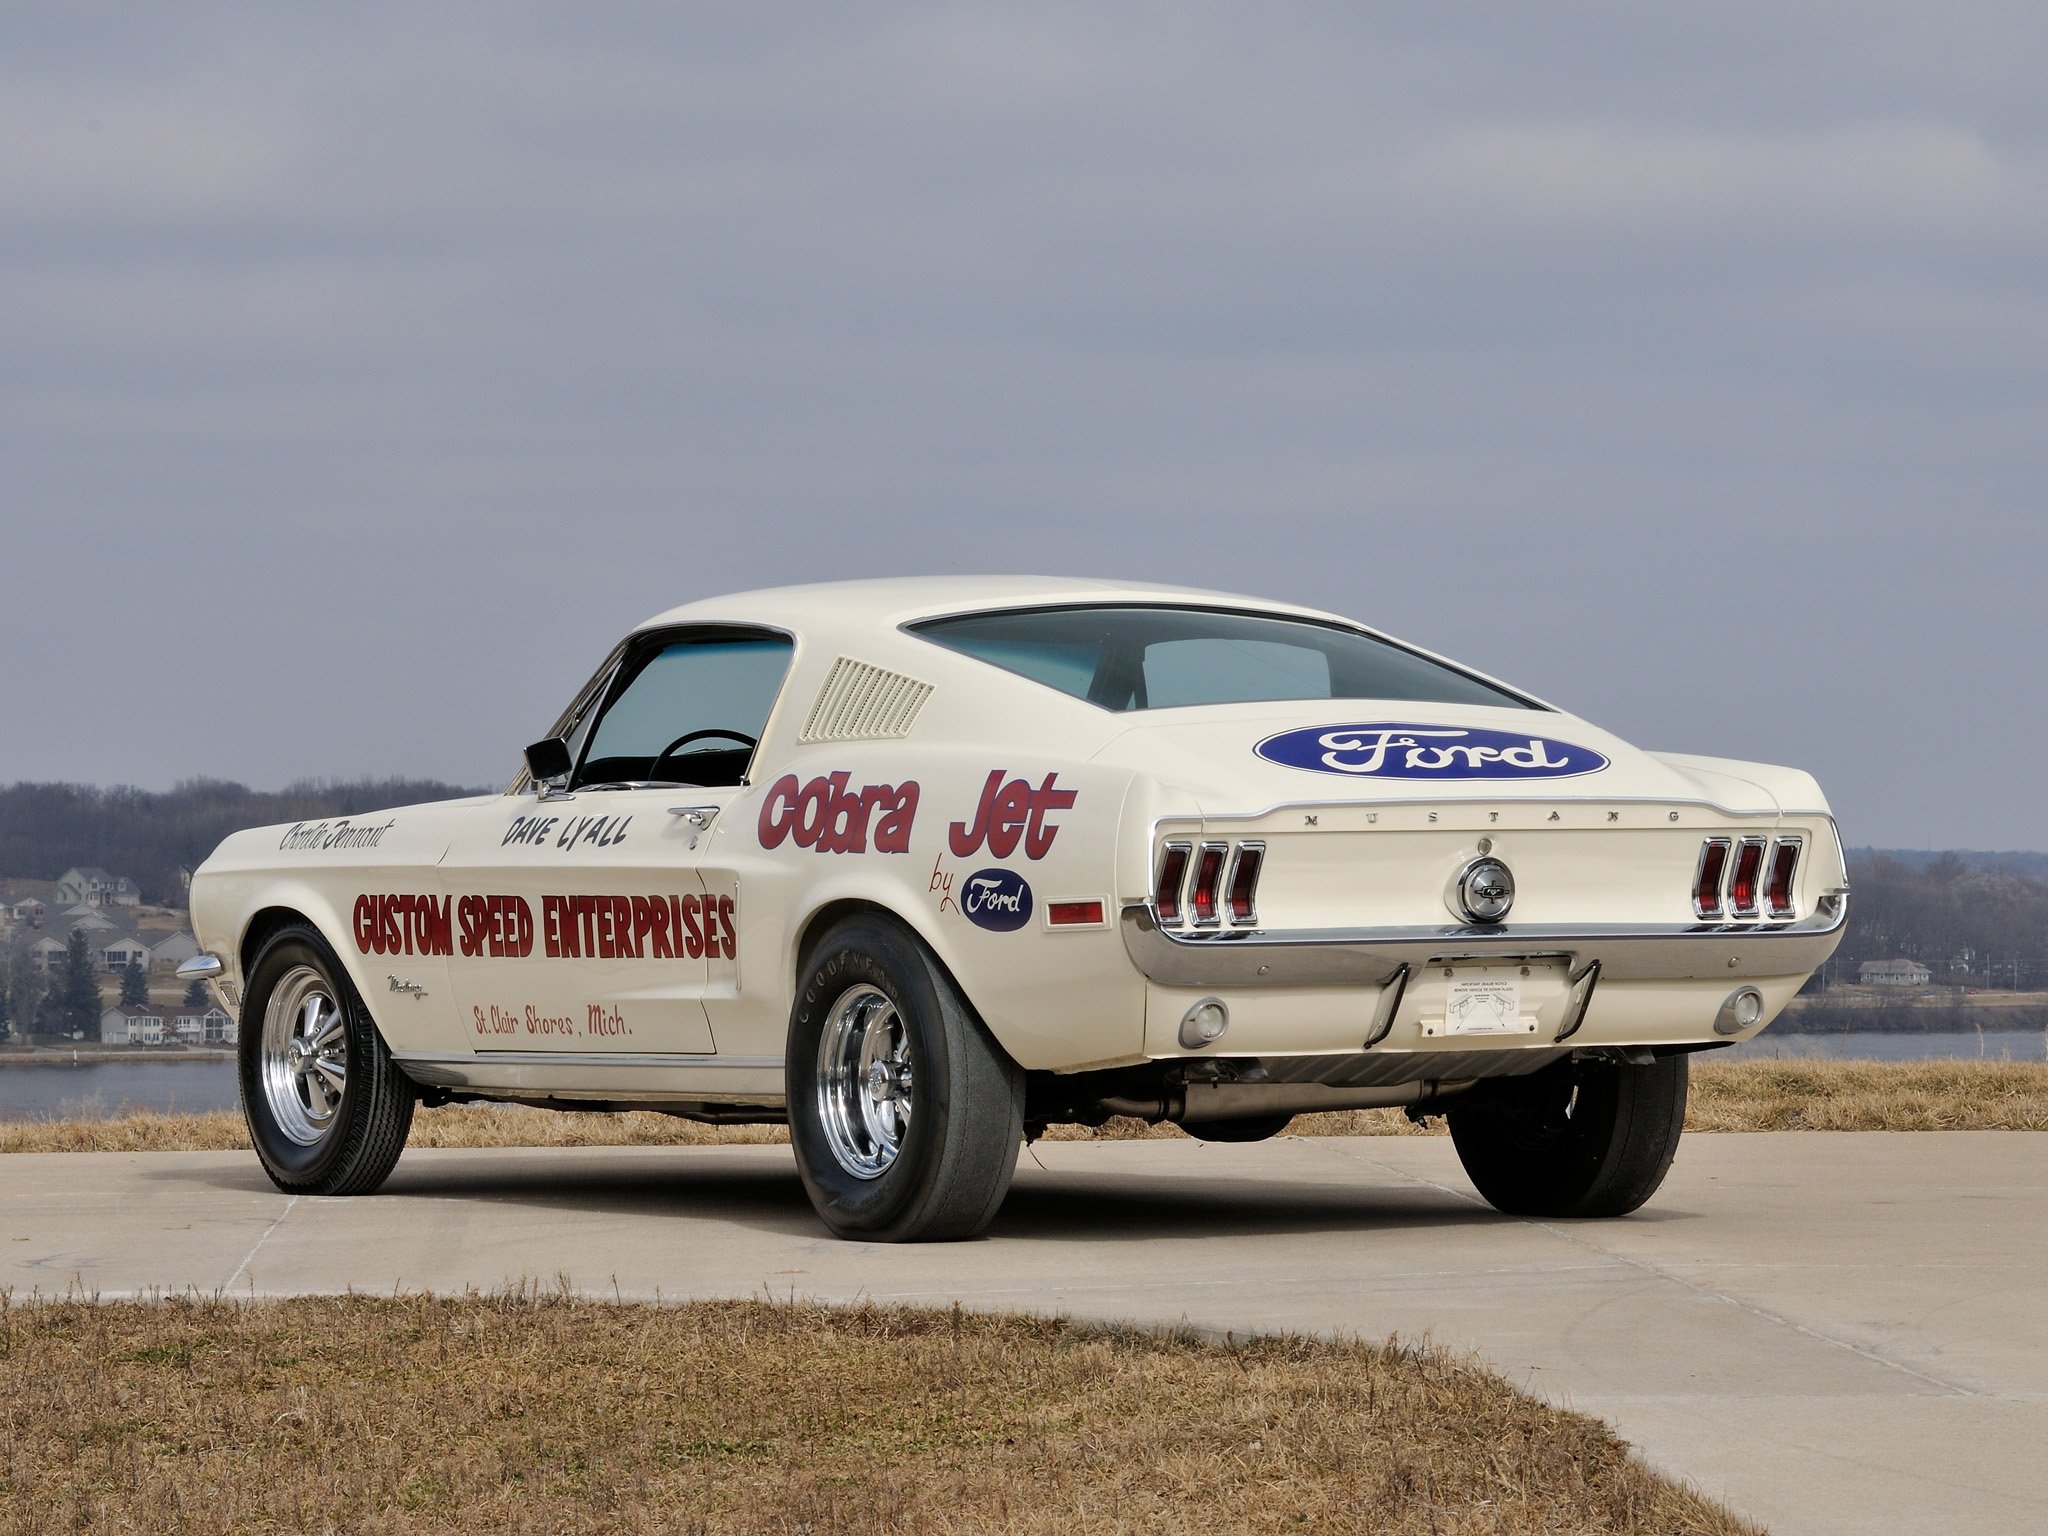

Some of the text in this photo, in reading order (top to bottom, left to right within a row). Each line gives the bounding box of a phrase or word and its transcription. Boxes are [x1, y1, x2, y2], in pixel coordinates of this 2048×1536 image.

[1318, 730, 1569, 773] Ford
[501, 815, 633, 852] DAVE LYALL
[758, 770, 1078, 860] Cobra Jet
[1304, 810, 1680, 826] MUSTANG
[929, 853, 960, 915] by
[966, 878, 1024, 913] Ford
[353, 894, 737, 960] CUSTOM SPEED ENTERPRISES
[387, 974, 429, 1001] Mustang
[587, 1004, 633, 1036] Mich.
